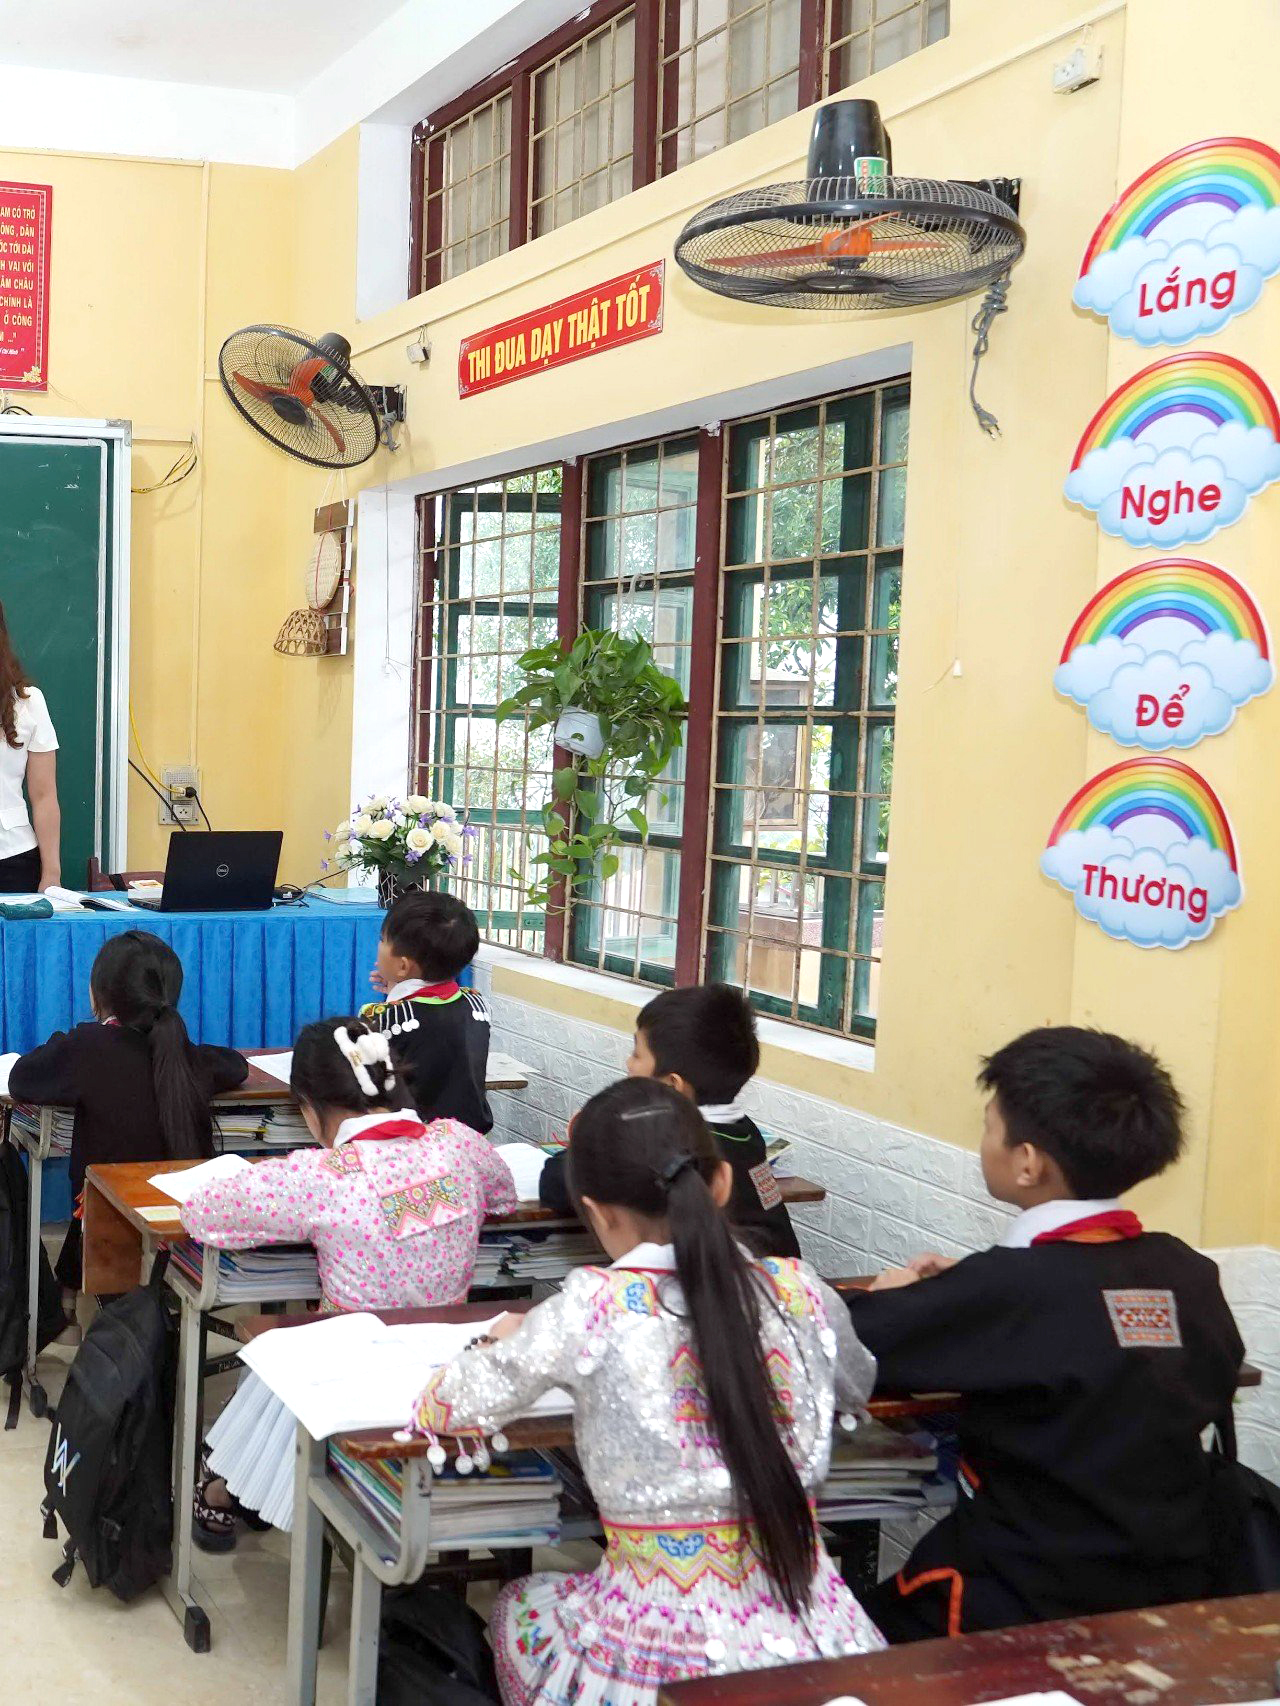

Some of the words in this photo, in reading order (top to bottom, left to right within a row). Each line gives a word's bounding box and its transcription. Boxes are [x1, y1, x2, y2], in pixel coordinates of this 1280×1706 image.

[12, 204, 22, 218] CÓ
[8, 260, 20, 272] VAI
[1138, 267, 1238, 318] Lắng
[468, 345, 491, 383] THI
[494, 334, 527, 375] ĐUA
[530, 318, 563, 366] DẠY
[567, 297, 612, 350] THẬT
[616, 274, 651, 331] TỐT
[1119, 480, 1222, 526] Nghe
[1136, 684, 1191, 729] Để
[1082, 864, 1209, 924] Thương
